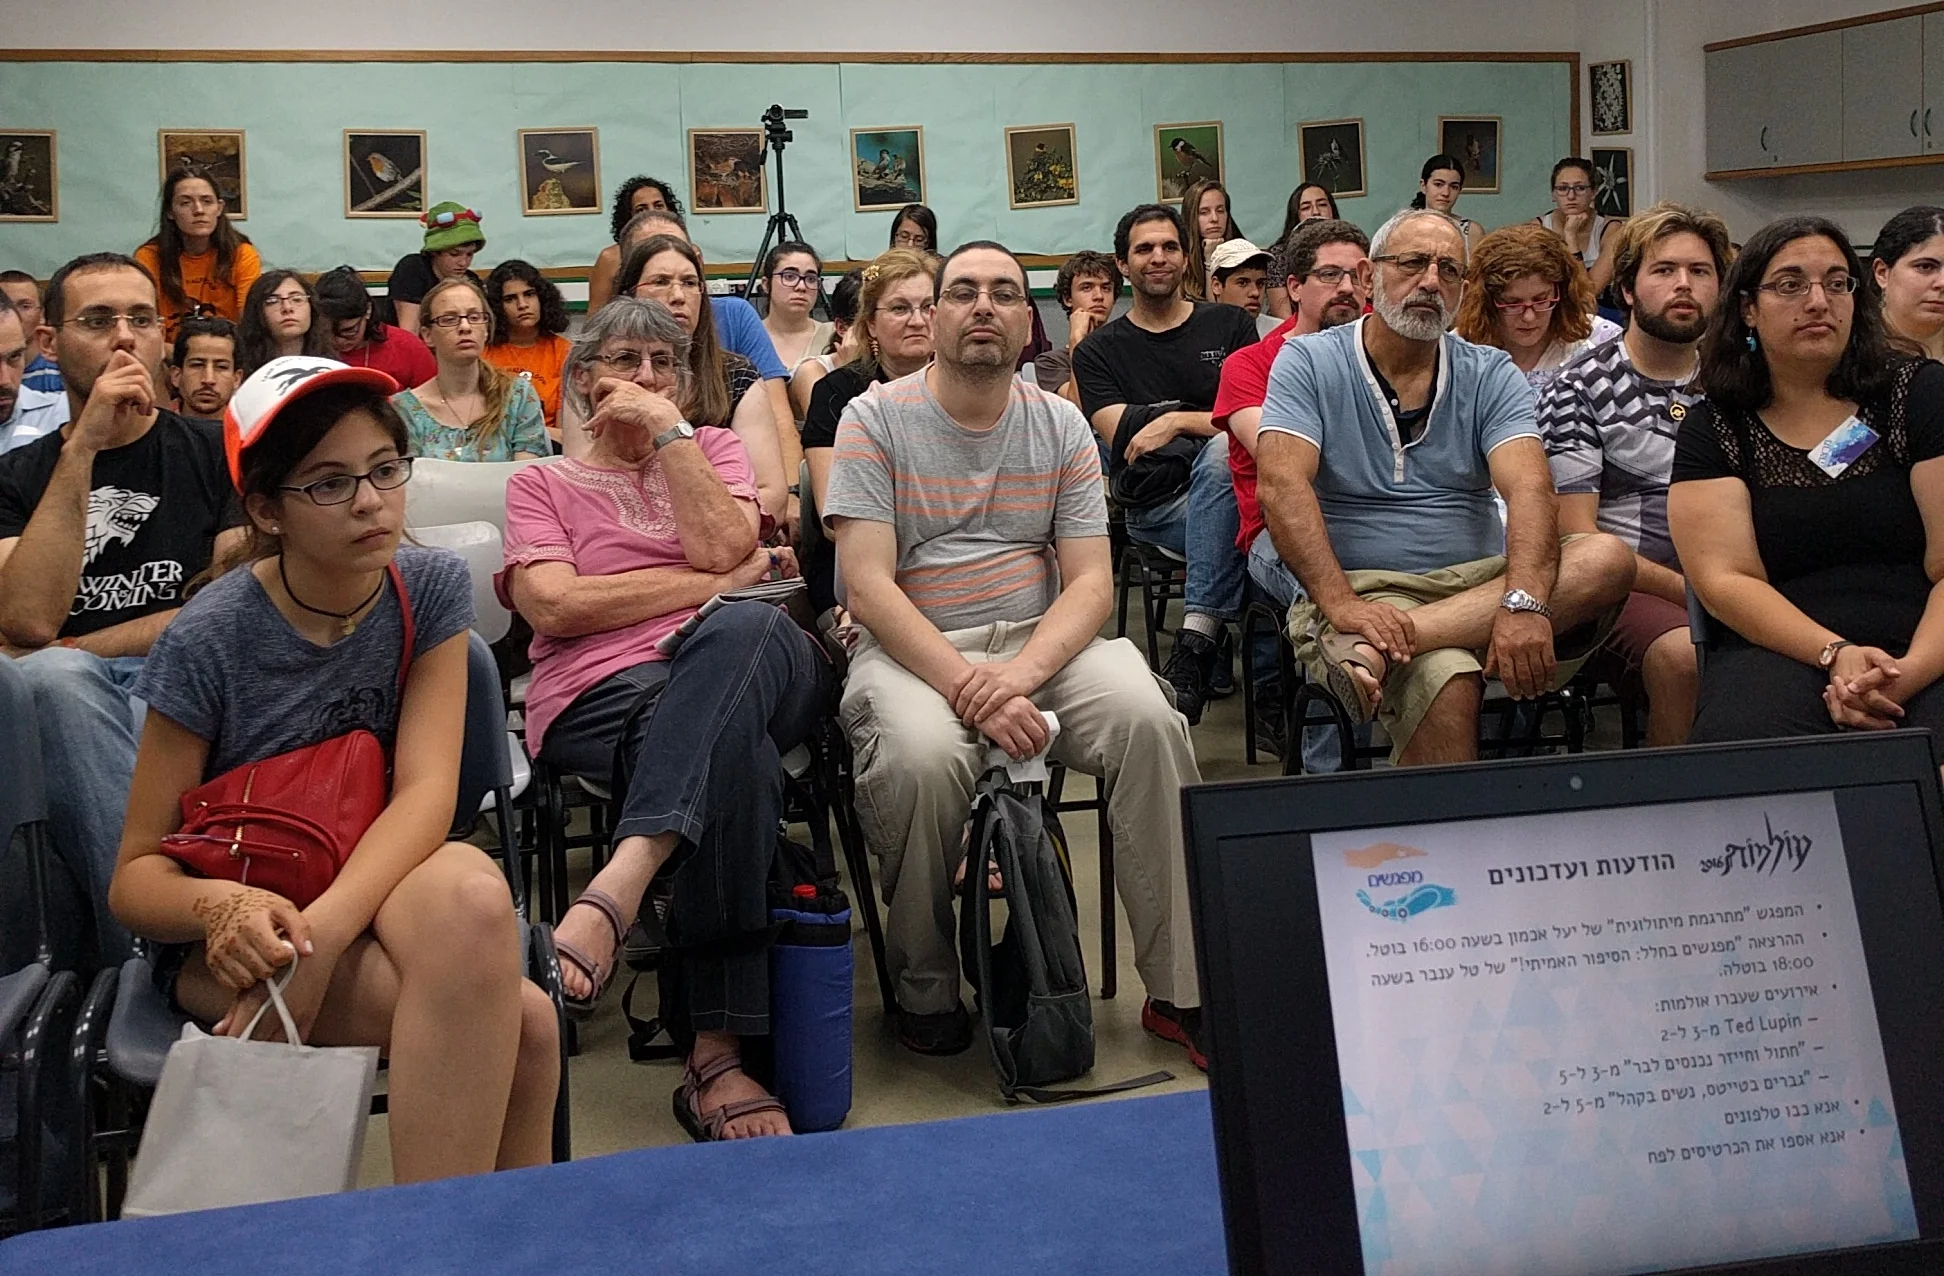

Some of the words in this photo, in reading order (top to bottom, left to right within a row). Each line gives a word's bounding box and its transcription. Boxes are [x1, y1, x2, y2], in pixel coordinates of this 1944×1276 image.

[80, 560, 183, 596] WINTER
[1488, 859, 1589, 886] ועדכונים
[1597, 853, 1675, 876] הודעות
[1367, 870, 1424, 888] מפגשים
[1756, 904, 1804, 921] המפגש
[1552, 923, 1577, 939] יעל
[1581, 922, 1602, 936] של
[1413, 937, 1456, 952] 16:00
[1461, 932, 1503, 947] בשעה
[1748, 932, 1804, 949] ההרצאה
[1366, 941, 1406, 957] בוטל.
[1636, 943, 1677, 961] בחלל:
[1583, 951, 1631, 966] הסיפור
[1773, 956, 1814, 971] 18:00
[1420, 966, 1454, 981] ענבר
[1460, 963, 1479, 977] טל
[1485, 960, 1505, 974] של
[1719, 960, 1767, 977] בוטלה.
[1371, 971, 1414, 986] בשעה
[1715, 991, 1759, 1006] שעברו
[1765, 984, 1818, 1000] אירועים
[1655, 996, 1709, 1013] אולמות:
[1725, 1017, 1754, 1034] Ted
[1760, 1013, 1802, 1032] Lupin
[1661, 1025, 1686, 1042] ל-2
[1665, 1054, 1713, 1071] נכנסים
[1718, 1048, 1760, 1066] וחייזר
[1559, 1066, 1587, 1085] ל-5
[1661, 1086, 1695, 1101] נשים
[1544, 1097, 1570, 1115] ל-2
[1786, 1105, 1810, 1119] כבו
[1815, 1101, 1840, 1114] אנא
[1724, 1108, 1780, 1125] טלפונים
[1756, 1138, 1775, 1151] את
[1781, 1134, 1815, 1149] אספו
[1820, 1130, 1845, 1144] אנא
[1648, 1149, 1676, 1165] לפח
[1681, 1140, 1751, 1160] הכרטיסים
